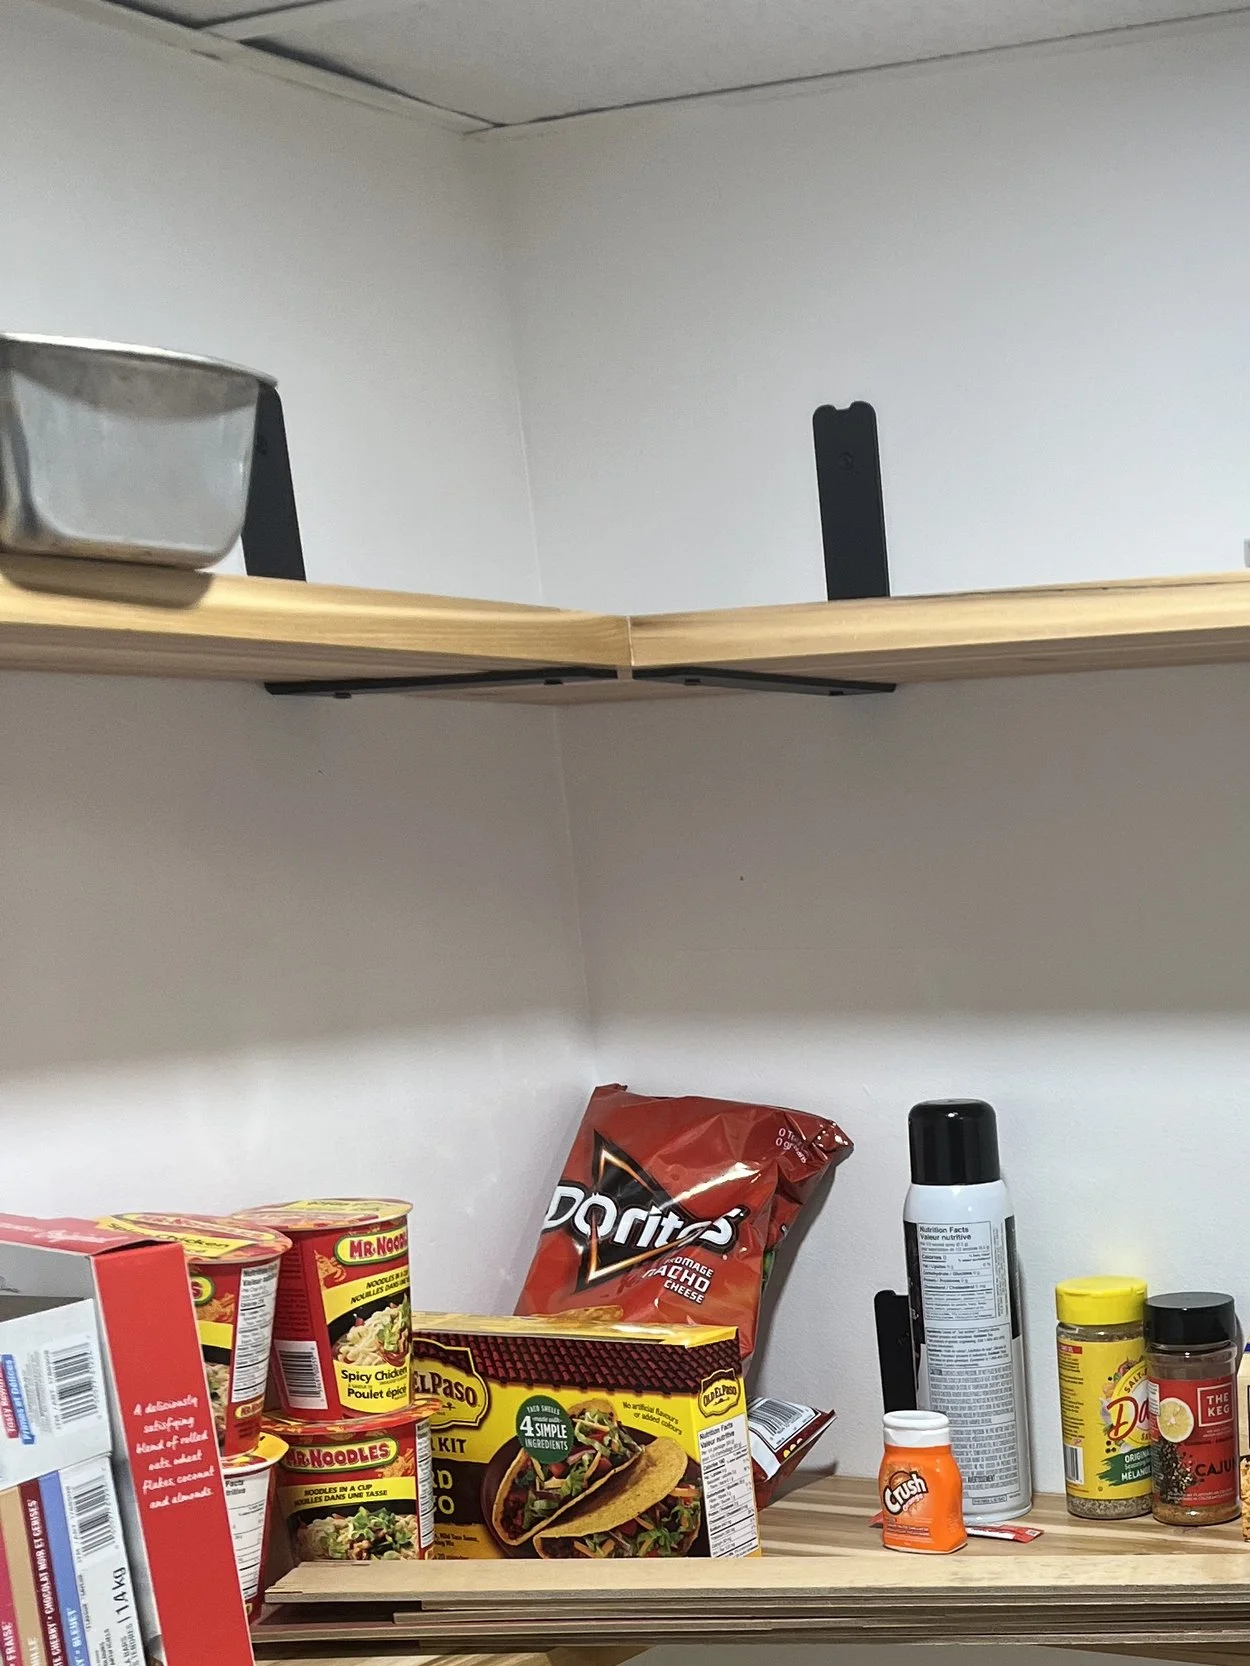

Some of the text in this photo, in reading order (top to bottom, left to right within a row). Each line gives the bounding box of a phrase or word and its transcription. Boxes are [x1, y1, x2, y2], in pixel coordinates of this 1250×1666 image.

[663, 1279, 705, 1304] CHEESE
[341, 1370, 372, 1384] Spicy
[347, 1388, 384, 1399] Poulet
[704, 1391, 714, 1407] OLD
[1206, 1392, 1229, 1405] THE
[632, 1401, 655, 1413] artificial
[655, 1408, 679, 1425] flavours
[1207, 1404, 1230, 1417] KEG
[143, 1417, 195, 1433] satisfying
[520, 1415, 568, 1439] 4 SIMPLE
[641, 1412, 661, 1424] added
[661, 1420, 683, 1436] colours
[136, 1429, 208, 1454] blend of rolled
[438, 1437, 467, 1453] KIT
[524, 1438, 569, 1451] INGREDIENTS
[173, 1449, 203, 1465] wheat
[309, 1443, 390, 1469] NOODLES
[176, 1465, 215, 1484] coconut
[304, 1487, 337, 1497] NOODLES
[357, 1484, 373, 1492] CUP
[324, 1494, 345, 1502] DANS
[348, 1491, 364, 1499] UNE
[366, 1490, 388, 1498] TASSE
[884, 1472, 928, 1514] Crush
[149, 1496, 171, 1509] and
[112, 1566, 127, 1590] kg
[37, 1571, 53, 1613] CHOCOLAT
[45, 1622, 60, 1655] CHERRY
